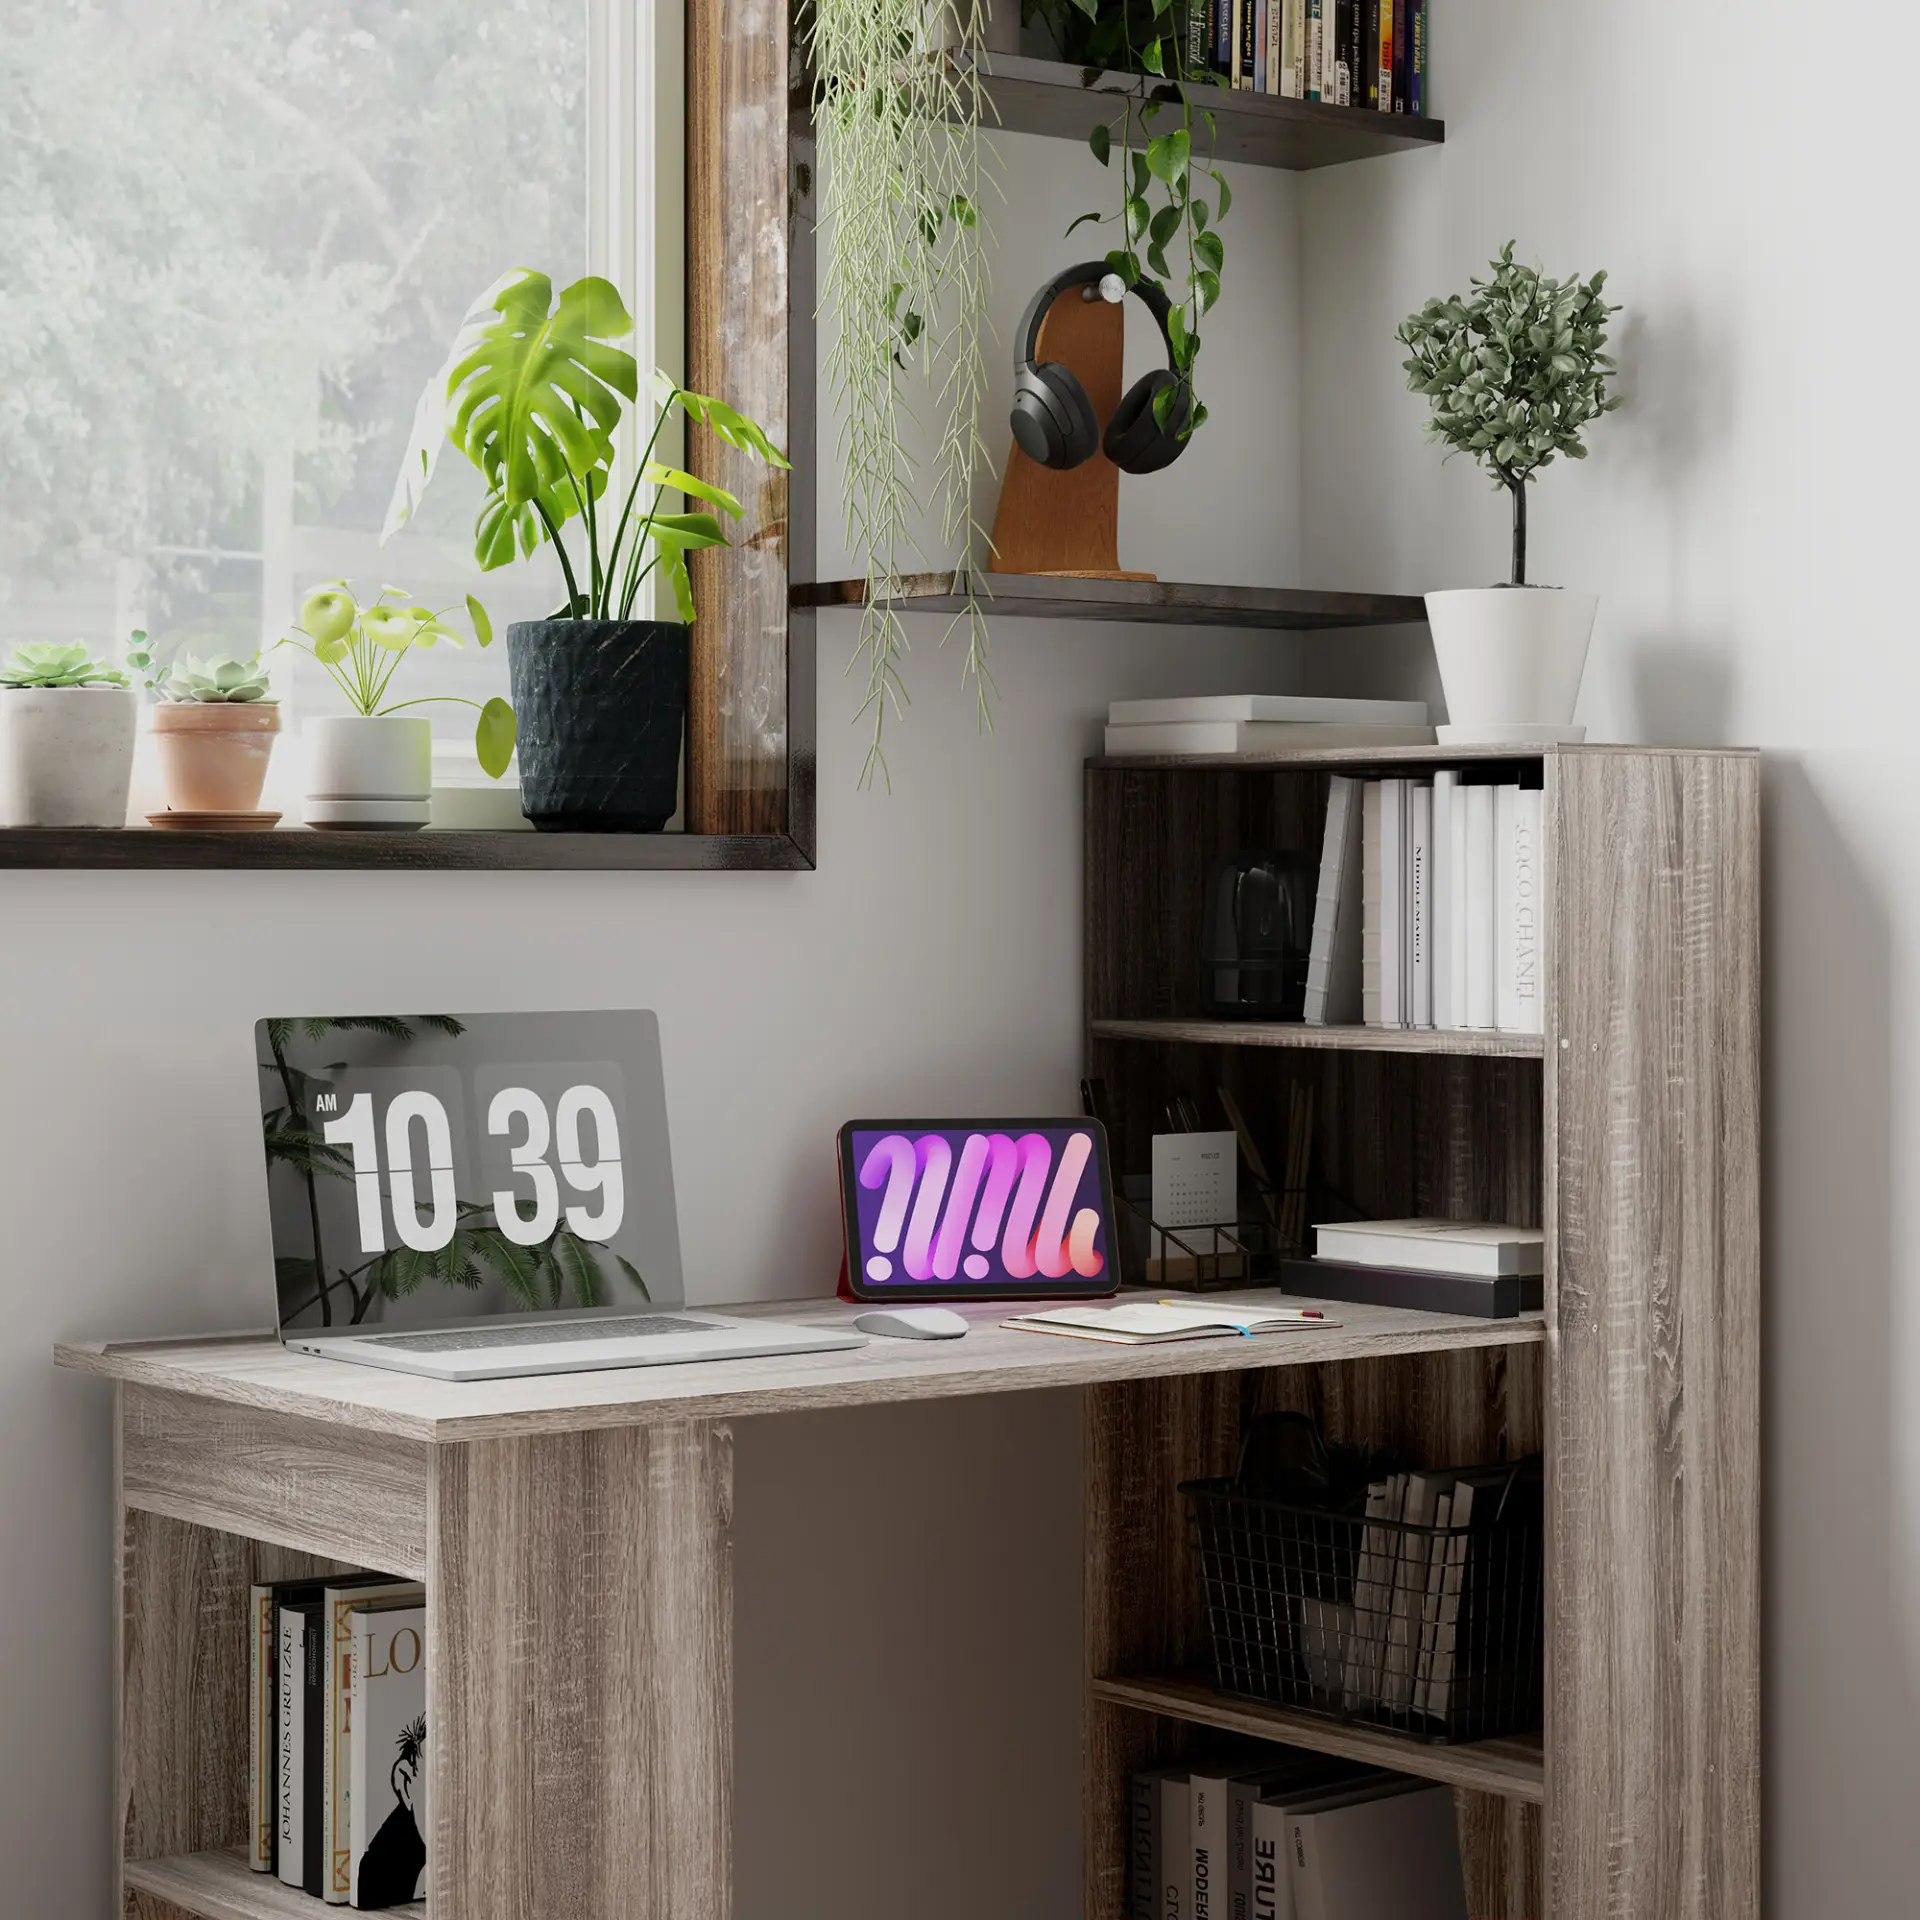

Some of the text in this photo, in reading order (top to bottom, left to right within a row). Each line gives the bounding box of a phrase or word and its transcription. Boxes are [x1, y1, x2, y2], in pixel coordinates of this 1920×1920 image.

[1515, 824, 1535, 1006] COCO CHANEL
[316, 1094, 337, 1112] AM
[323, 1084, 626, 1253] 10 39
[281, 1626, 293, 1844] JOHANNES GRÜTZKE
[363, 1628, 426, 1678] LO
